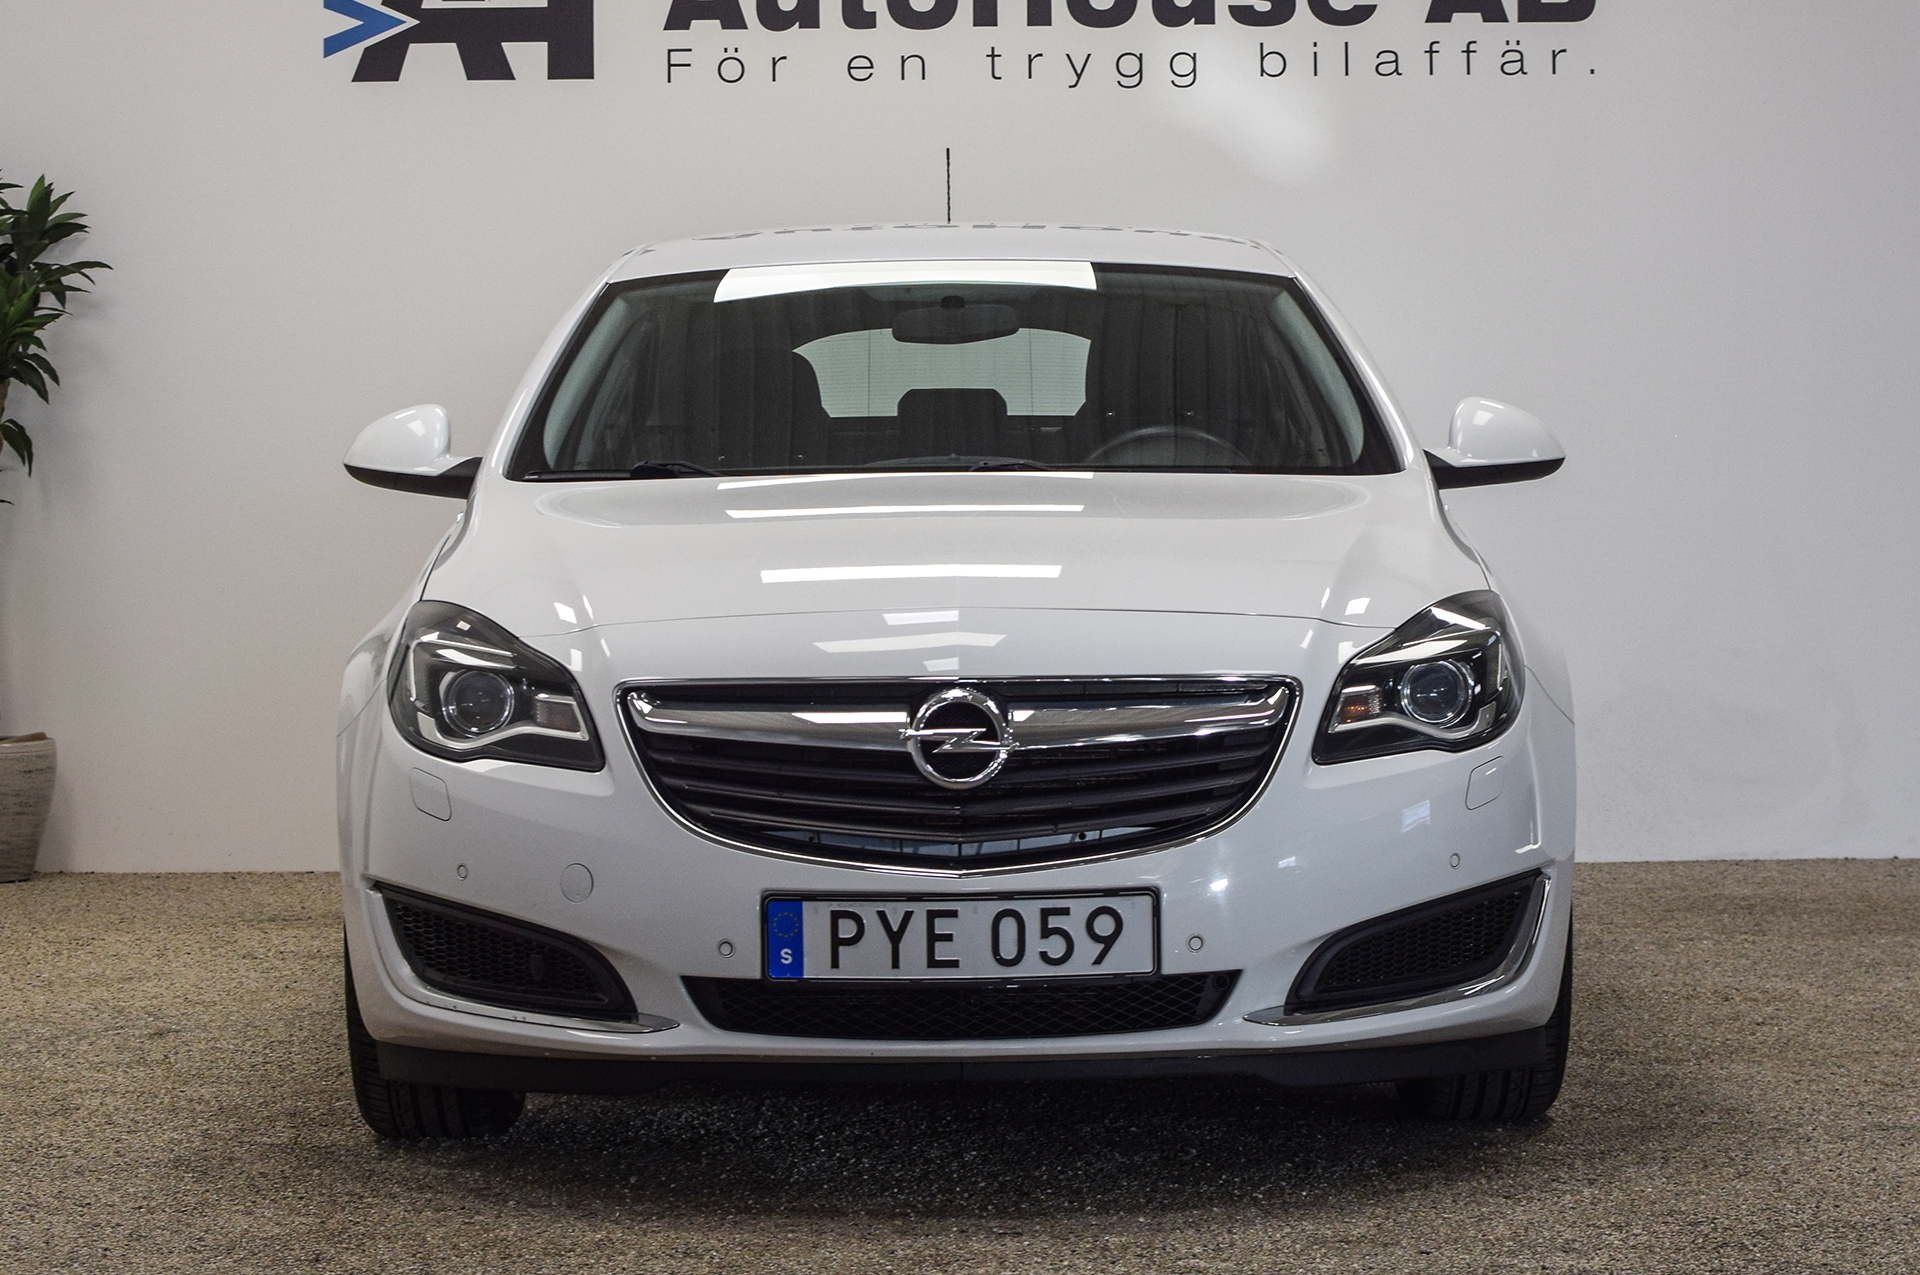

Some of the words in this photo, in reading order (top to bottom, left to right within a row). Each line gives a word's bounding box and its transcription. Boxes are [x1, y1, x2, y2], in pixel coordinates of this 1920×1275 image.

[667, 47, 788, 83] För
[847, 54, 926, 82] en
[986, 46, 1197, 88] trygg
[1259, 40, 1595, 78] bilaffär.
[780, 948, 793, 965] S
[829, 908, 960, 969] PYE
[990, 905, 1124, 968] 059
